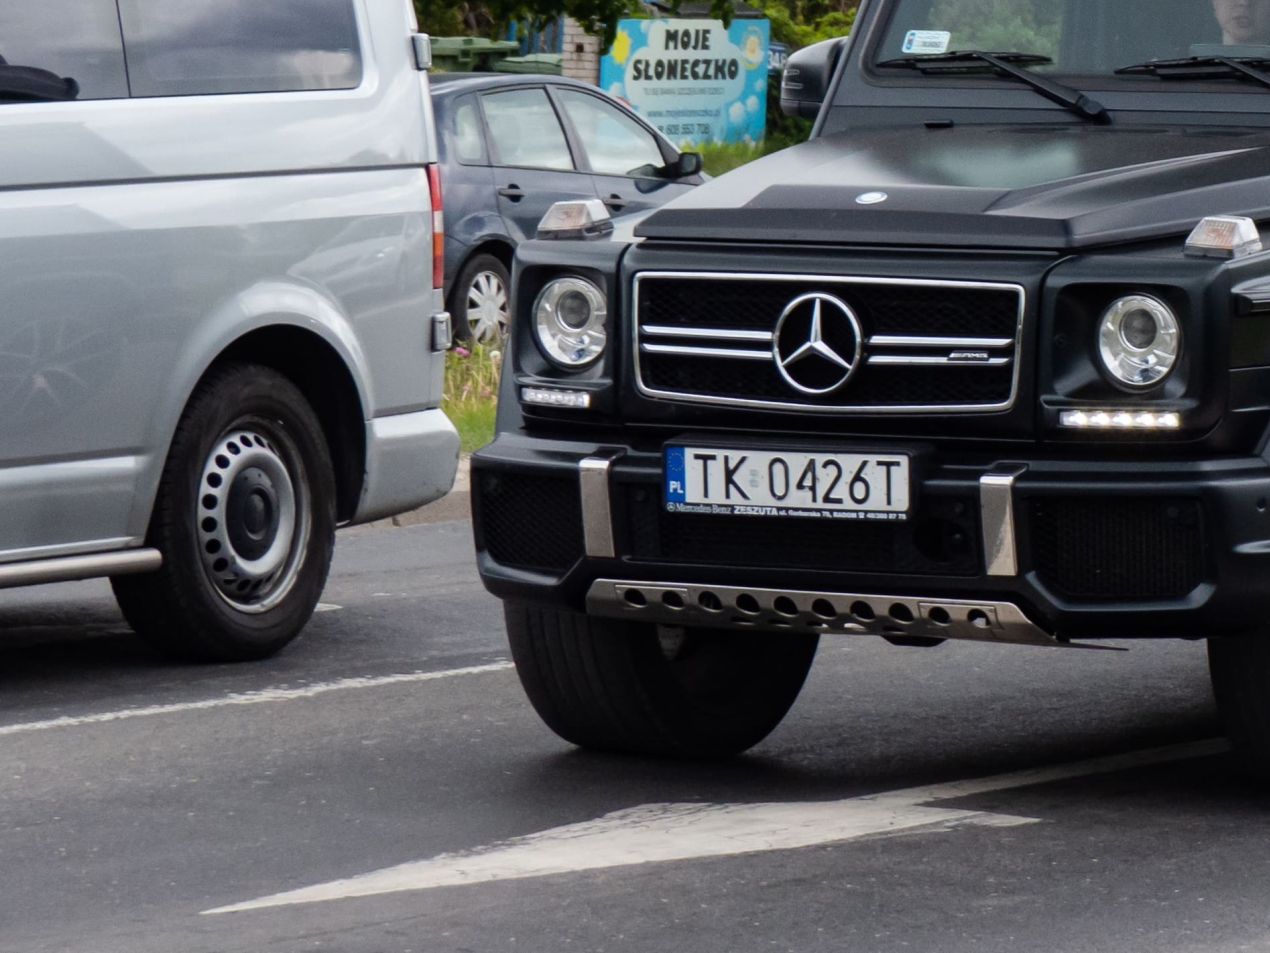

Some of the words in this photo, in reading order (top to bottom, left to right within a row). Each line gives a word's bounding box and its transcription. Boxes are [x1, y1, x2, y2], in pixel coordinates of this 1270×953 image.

[664, 28, 711, 51] MOJE
[632, 58, 739, 81] SŁONECZKO
[668, 480, 684, 494] PL
[693, 452, 751, 501] TK
[768, 456, 901, 507] 0426T
[676, 502, 732, 515] Mercedes-Benz
[733, 505, 779, 516] ZESZUTA
